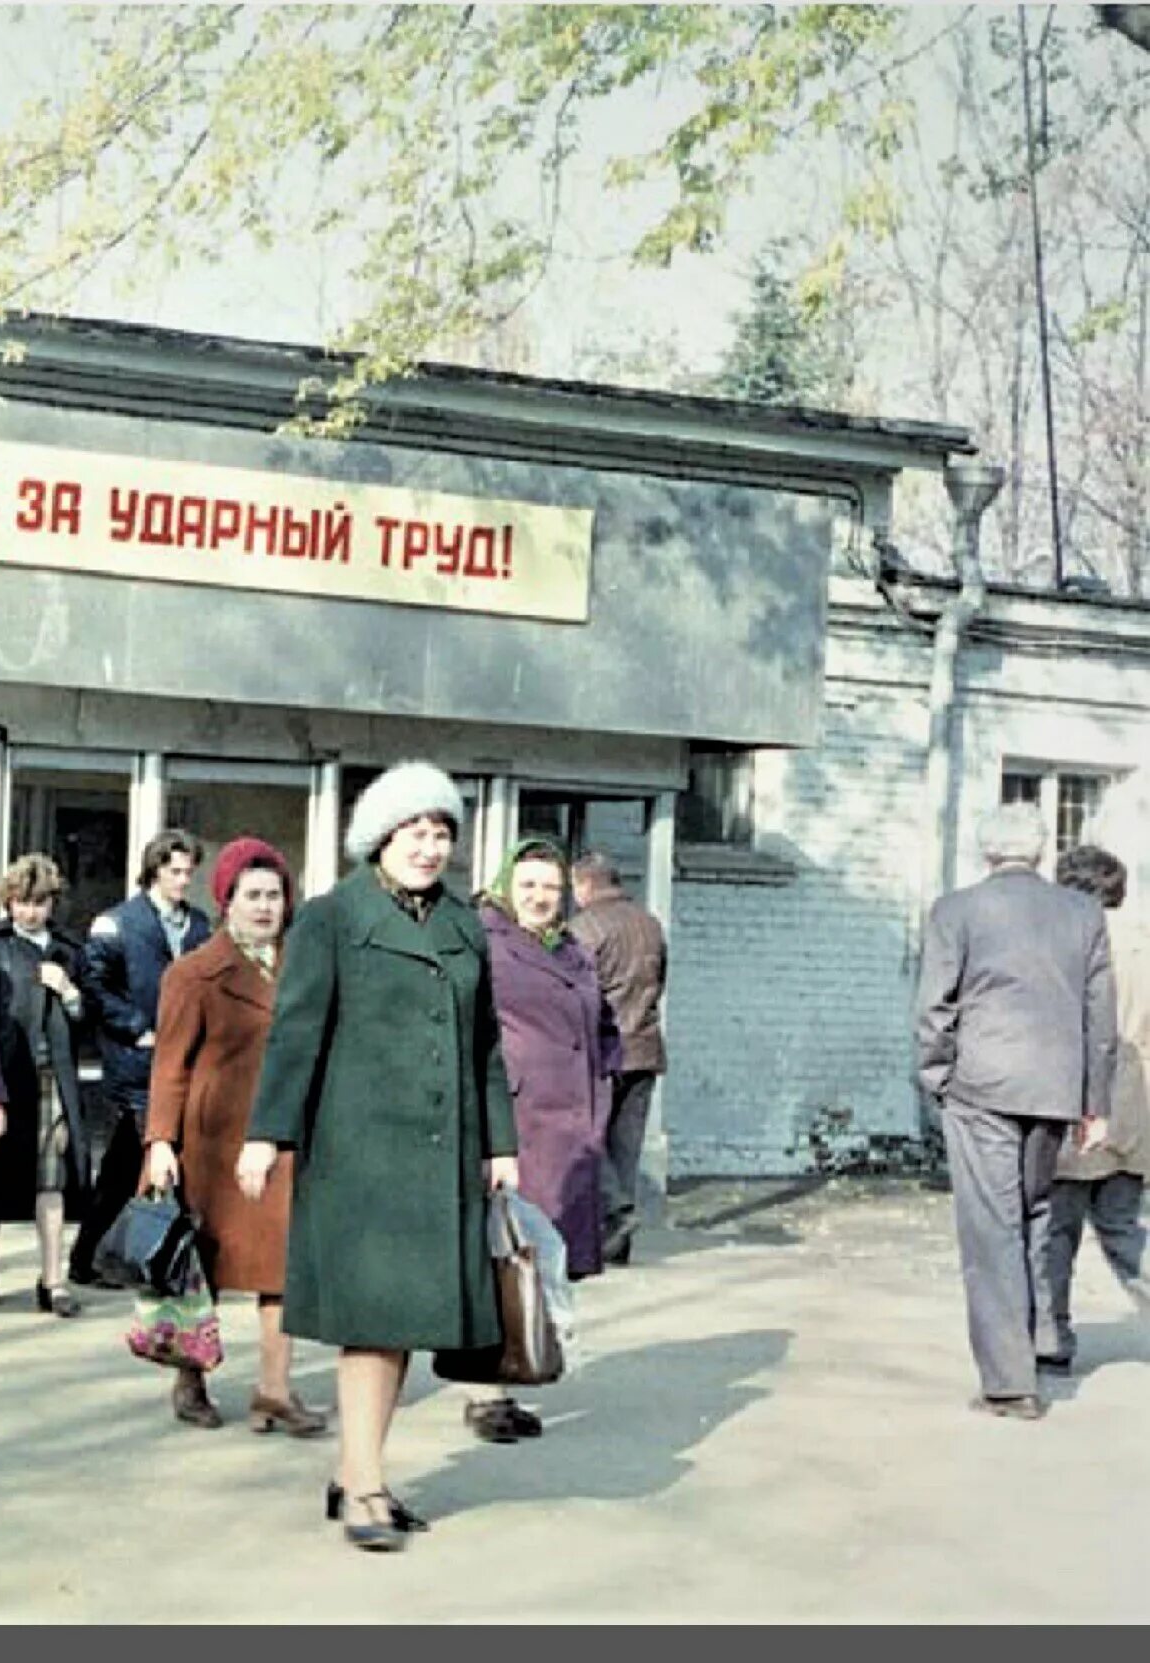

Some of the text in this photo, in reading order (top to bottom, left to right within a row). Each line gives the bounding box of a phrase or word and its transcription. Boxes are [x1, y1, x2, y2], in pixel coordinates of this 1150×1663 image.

[16, 479, 83, 536] ЗА
[109, 487, 352, 565] УДАРНЫЙ
[375, 517, 512, 581] ТРУД!
